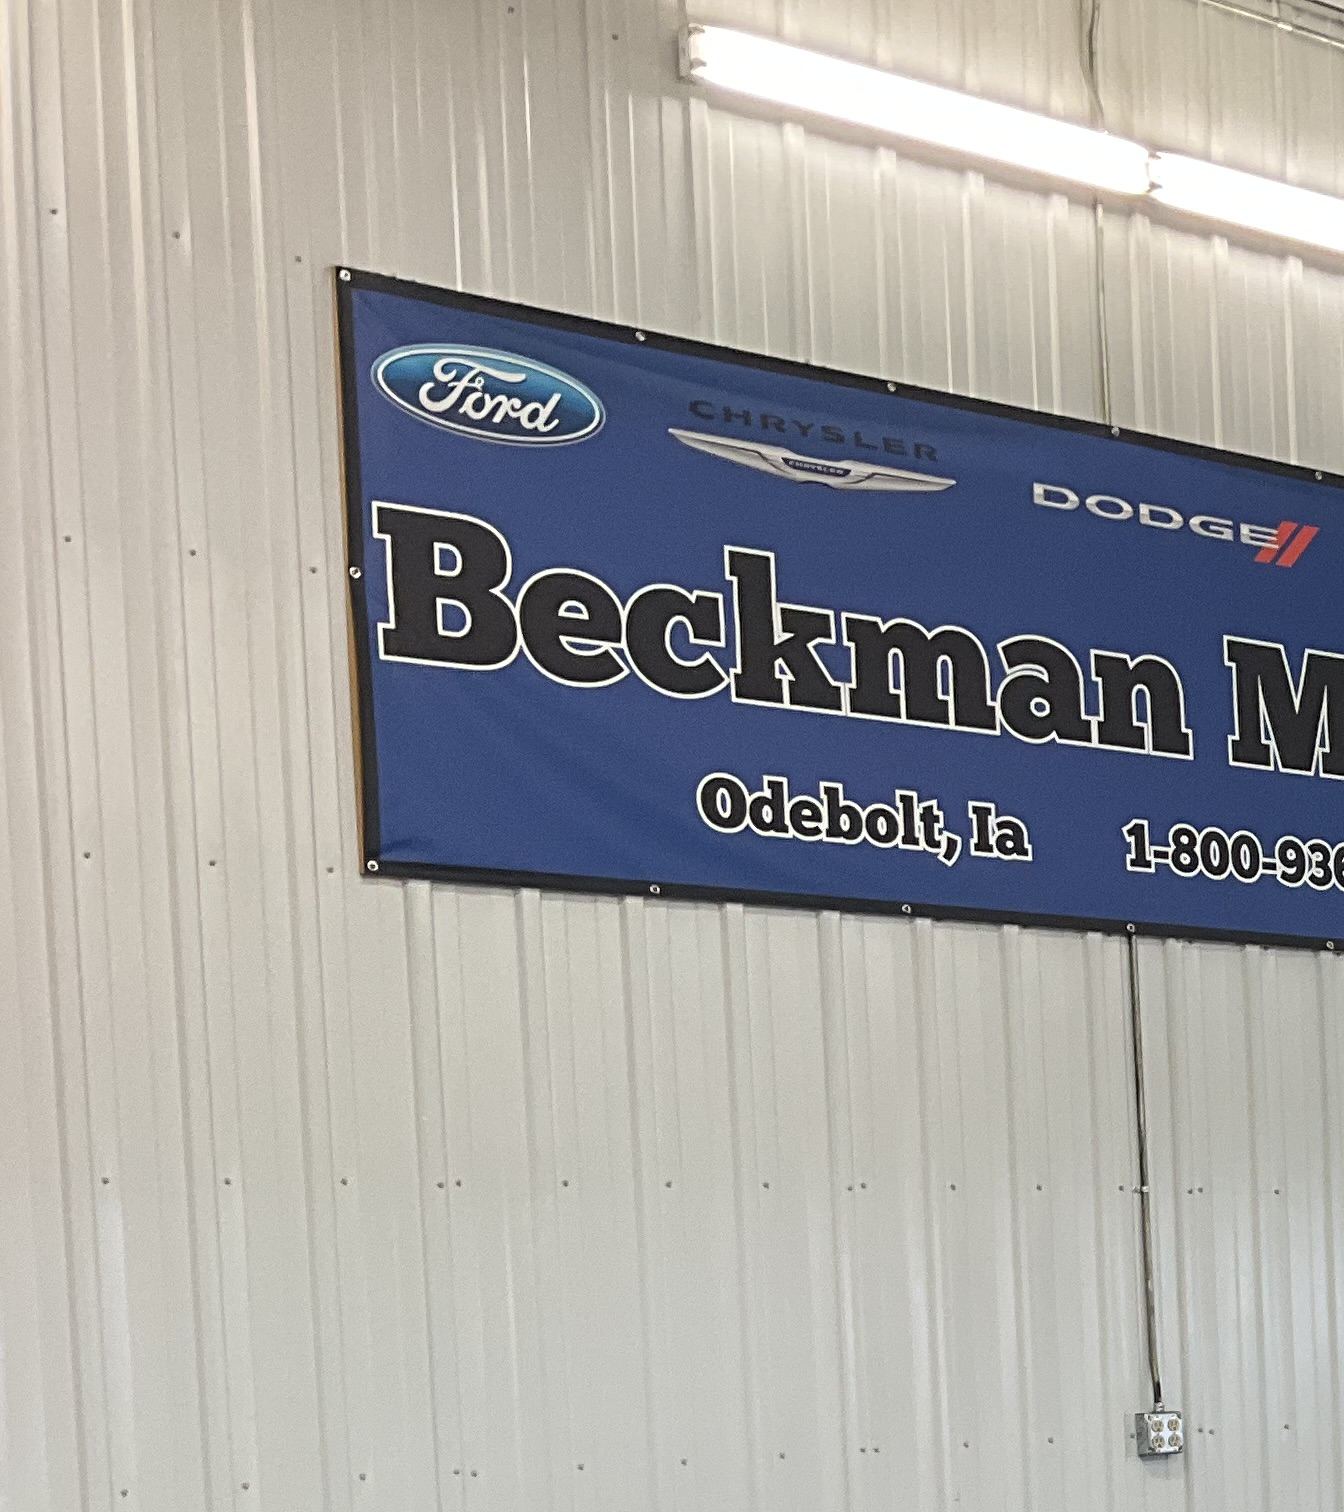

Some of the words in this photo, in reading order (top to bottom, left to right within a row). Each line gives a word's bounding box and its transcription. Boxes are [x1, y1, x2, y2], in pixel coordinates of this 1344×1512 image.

[418, 356, 561, 435] Ford
[688, 399, 938, 463] CHRYSLER
[1032, 482, 1279, 550] DODGE
[372, 500, 1194, 759] Beckman
[696, 772, 960, 865] Odebolt,
[968, 802, 1032, 860] Ia
